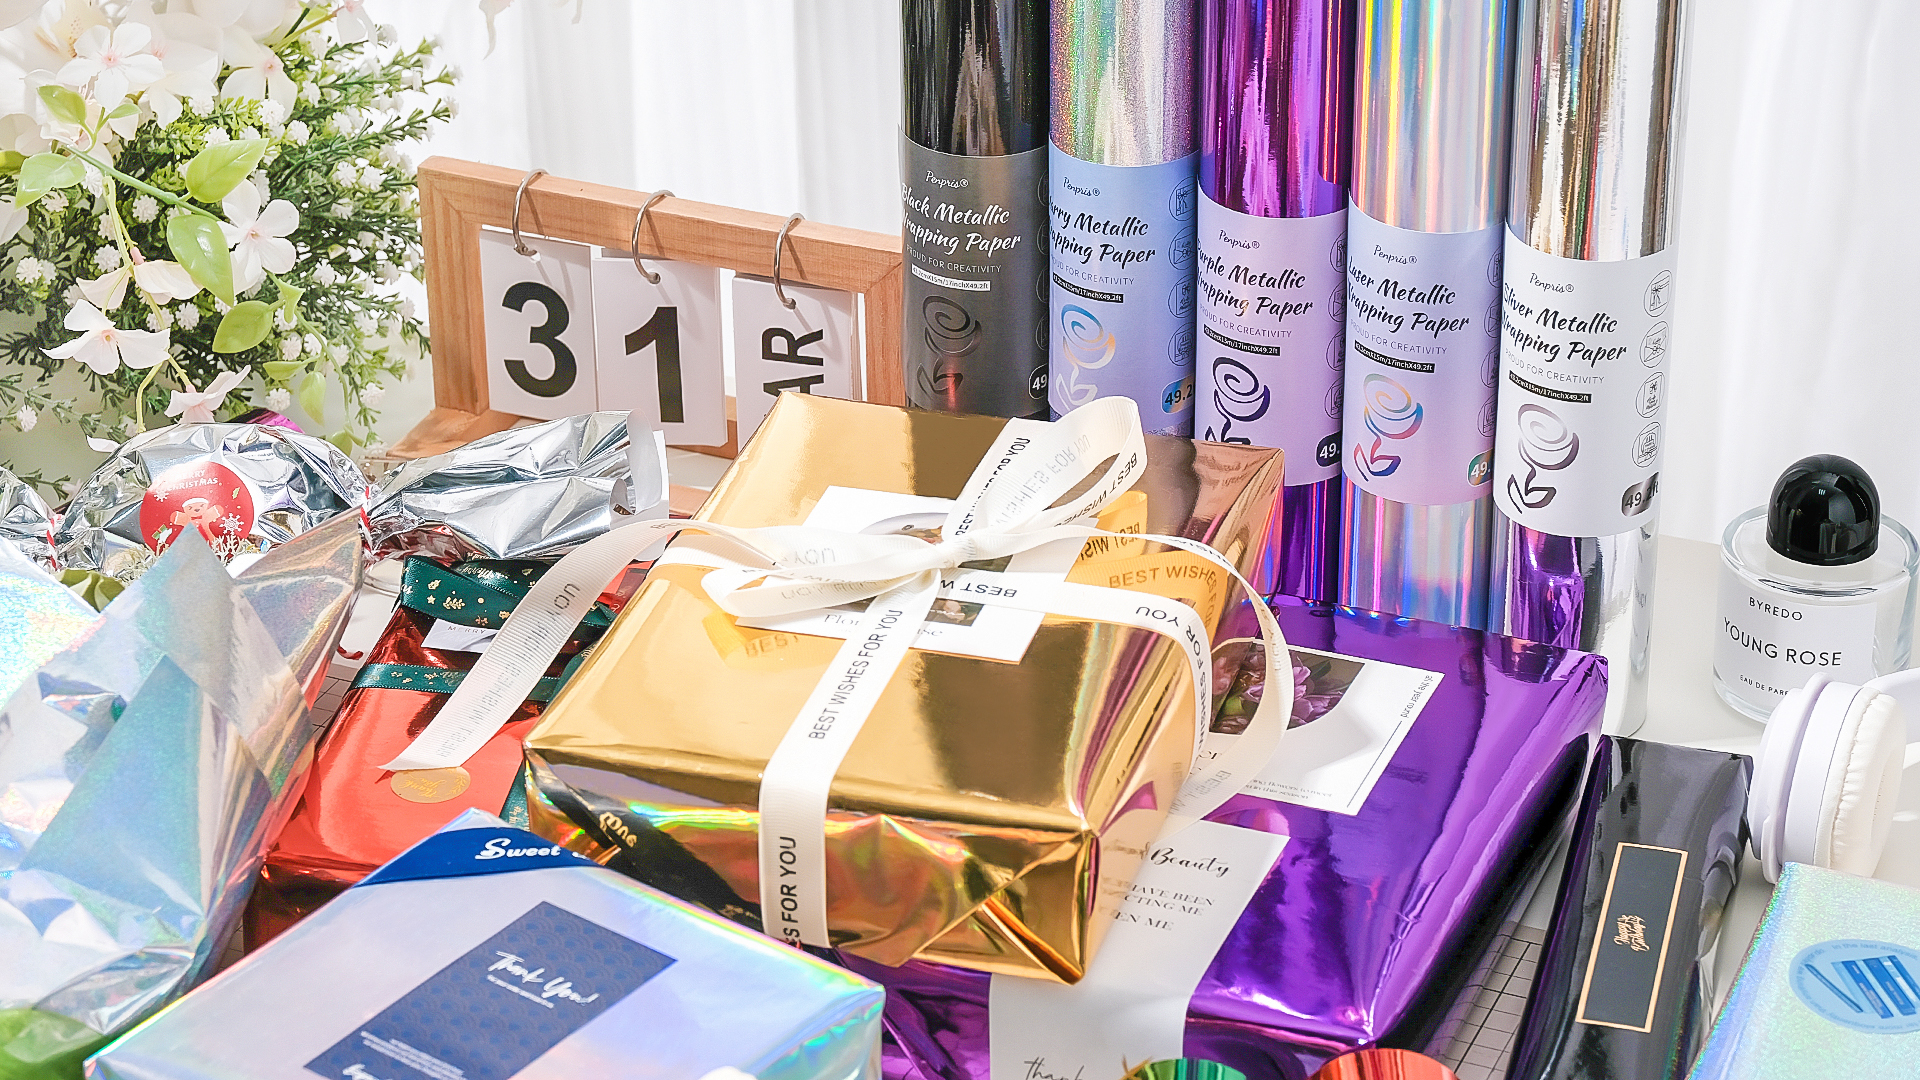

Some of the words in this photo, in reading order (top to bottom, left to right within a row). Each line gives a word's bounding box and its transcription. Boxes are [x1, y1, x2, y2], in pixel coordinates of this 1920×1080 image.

[902, 182, 930, 218] Black
[933, 202, 1010, 226] Metallic
[1073, 212, 1149, 237] Metallic
[965, 232, 1021, 258] Paper
[1099, 243, 1156, 269] Paper
[928, 256, 945, 269] FOR
[947, 262, 1002, 273] CREATIVITY
[1065, 264, 1080, 277] FOR
[1081, 271, 1135, 285] CREATIVITY
[1227, 264, 1306, 289] Metallic
[1376, 278, 1456, 305] Metallic
[1255, 296, 1314, 322] Paper
[1503, 282, 1533, 319] Sliver
[1535, 307, 1618, 335] Metallic
[1219, 317, 1235, 330] FOR
[1236, 324, 1293, 338] CREATIVITY
[1410, 312, 1470, 339] Paper
[501, 281, 577, 398] 3
[1371, 334, 1388, 347] FOR
[1390, 340, 1448, 355] CREATIVITY
[624, 306, 685, 424] 1
[762, 327, 825, 400] AR
[1566, 341, 1627, 368] Paper
[1526, 365, 1544, 378] FOR
[1546, 370, 1605, 384] CREATIVITY
[1109, 568, 1160, 589] BEST
[1136, 606, 1179, 627] YOU
[1749, 596, 1803, 621] BYREDO
[1724, 616, 1778, 659] YOUNG
[1786, 648, 1842, 666] ROSE
[808, 708, 840, 740] BEST
[830, 660, 870, 705] WISHES
[857, 633, 888, 658] FOR
[875, 609, 903, 634] YOU
[1739, 674, 1753, 686] EAU
[1755, 681, 1765, 691] DE
[475, 837, 561, 860] Sweet
[779, 836, 798, 877] YOU
[1150, 847, 1230, 878] Beauty
[781, 885, 800, 923] FOR
[1179, 904, 1205, 916] ME
[1144, 917, 1175, 930] ME
[487, 950, 546, 984] Thank
